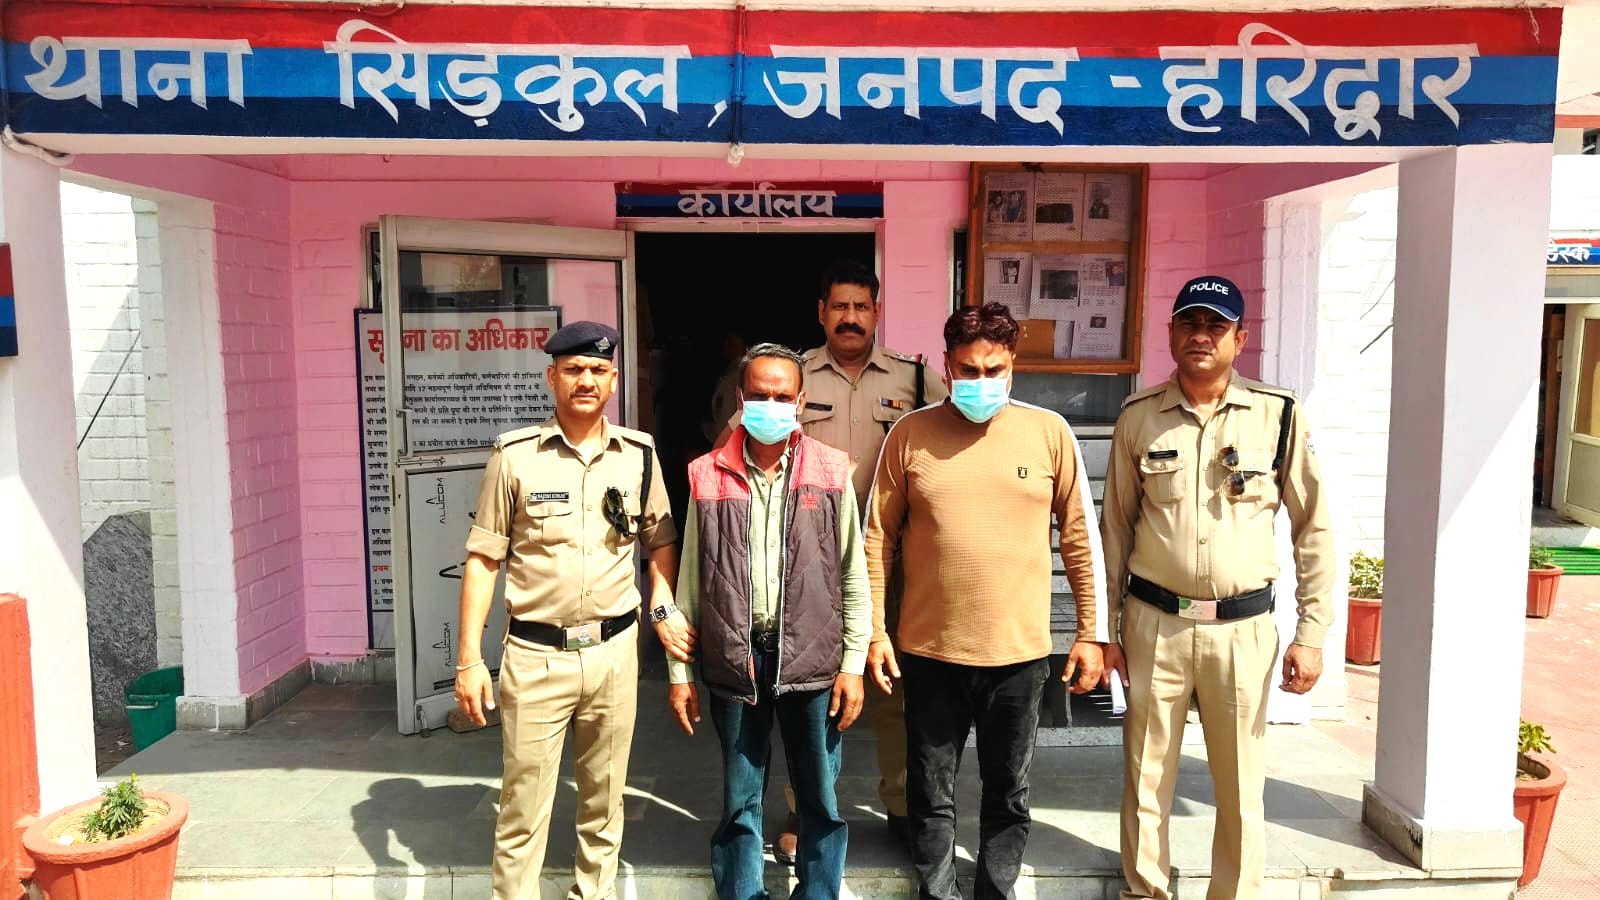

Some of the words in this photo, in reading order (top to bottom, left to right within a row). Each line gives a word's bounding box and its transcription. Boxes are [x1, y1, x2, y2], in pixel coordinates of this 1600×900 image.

[24, 36, 253, 110] थाना
[763, 44, 1080, 137] जनपद
[1158, 22, 1480, 141] हरिद्वार
[677, 182, 837, 218] कार्यालय
[1190, 281, 1230, 296] POLICE
[431, 328, 461, 352] का
[465, 318, 550, 352] अधिकार
